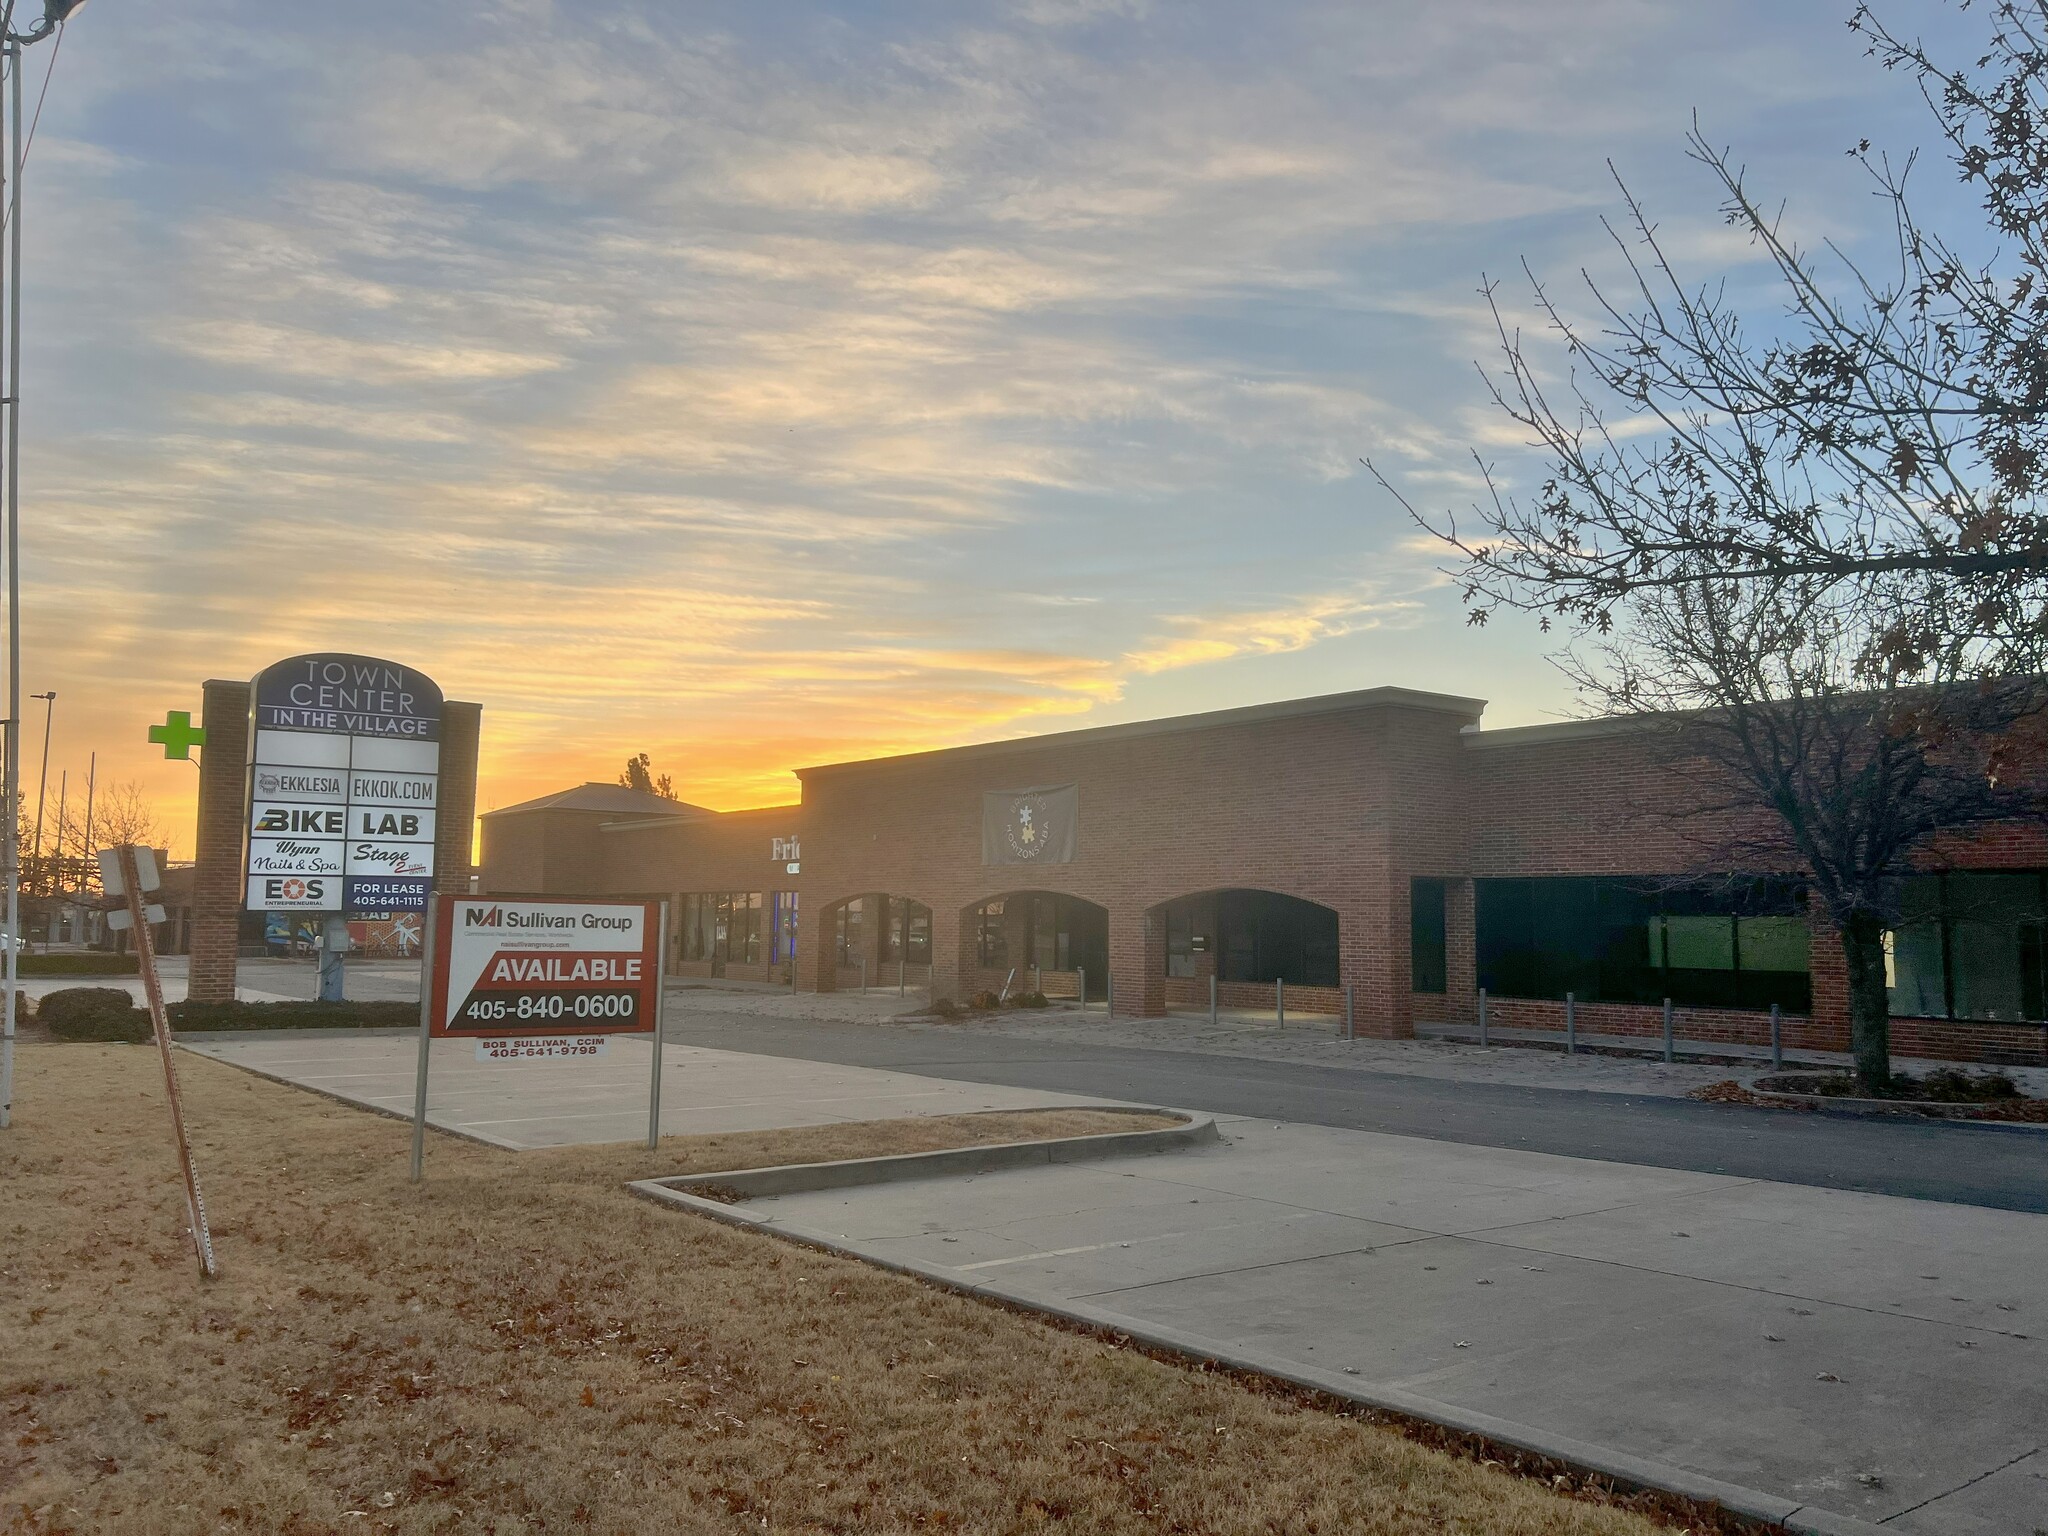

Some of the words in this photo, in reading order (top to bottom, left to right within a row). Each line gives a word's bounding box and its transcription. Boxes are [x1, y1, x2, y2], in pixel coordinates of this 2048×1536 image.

[305, 660, 402, 689] TOWN
[290, 683, 414, 714] CENTER
[273, 709, 294, 725] IN
[301, 711, 337, 728] THE
[343, 715, 427, 735] VILLAGE
[280, 775, 340, 793] EKKLESIA
[353, 778, 432, 800] EKKOK.COM
[254, 809, 343, 833] BIKE
[363, 812, 419, 836] LAB
[276, 841, 320, 857] Wynn
[1006, 824, 1040, 859] HORIZONS
[1039, 820, 1050, 848] ABA
[254, 857, 293, 870] Nails
[295, 859, 305, 870] &
[308, 857, 340, 873] Spa
[353, 844, 410, 866] Stage
[265, 878, 324, 900] EOS
[353, 883, 380, 894] FOR
[384, 884, 424, 894] LEASE
[353, 896, 424, 906] 405-641-1115
[465, 904, 503, 927] NAI
[506, 911, 576, 928] Sullivan
[581, 913, 633, 932] Group
[491, 958, 642, 982] AVAILABLE
[466, 994, 634, 1020] 405-840-0600
[482, 1041, 507, 1049] BOB
[513, 1039, 571, 1048] SULLIVAN,
[576, 1038, 605, 1046] CCIM
[489, 1046, 598, 1058] 405-641-9798
